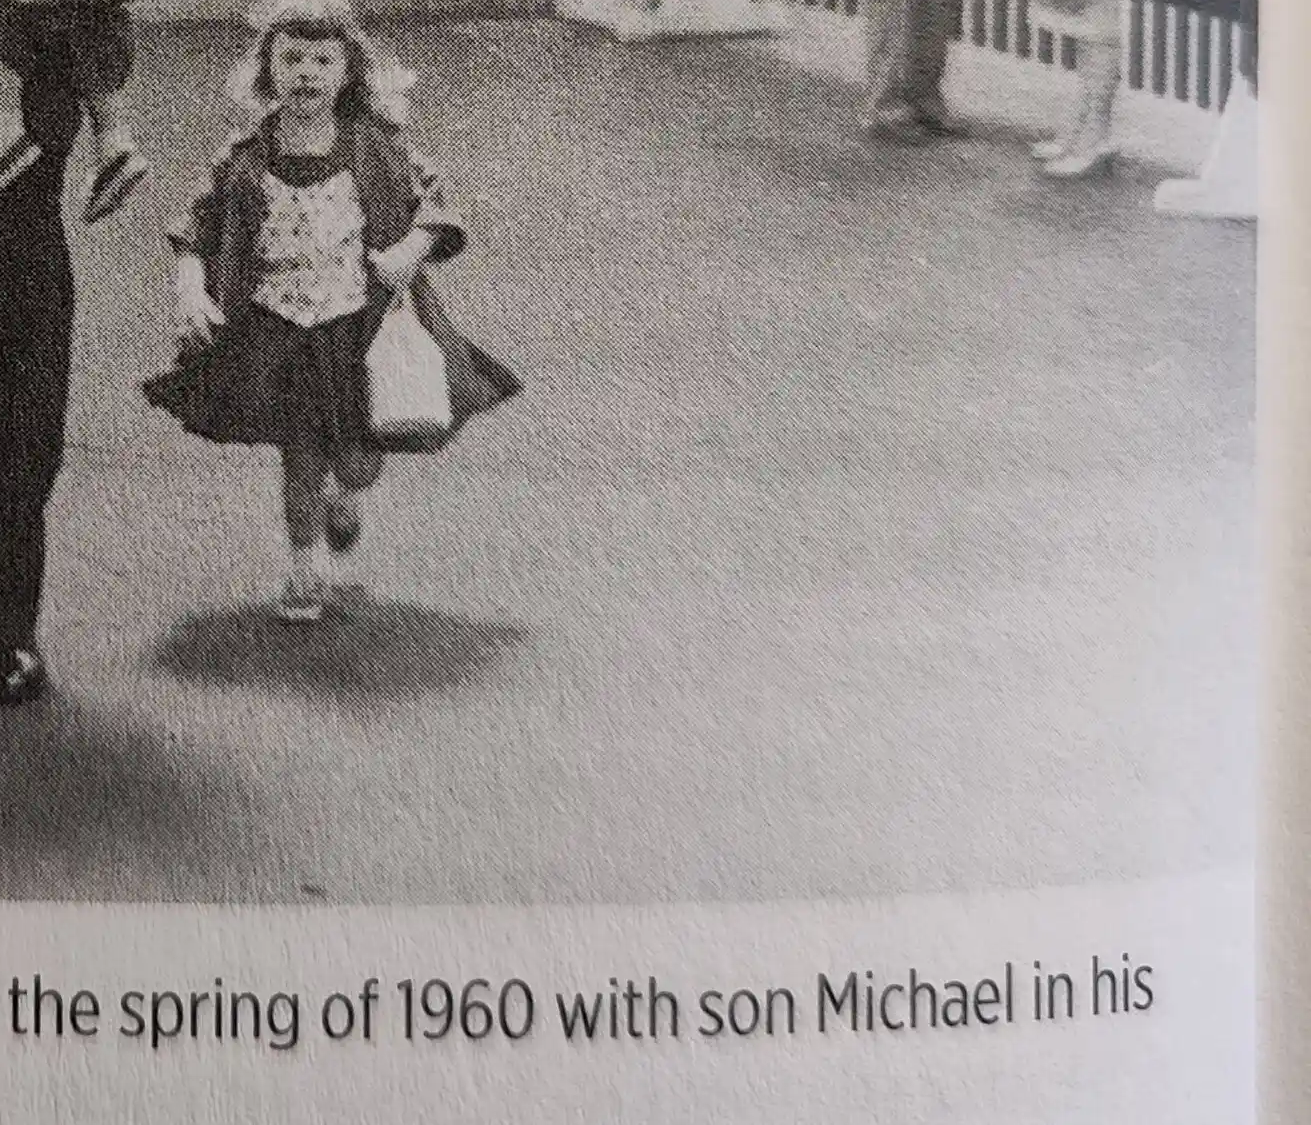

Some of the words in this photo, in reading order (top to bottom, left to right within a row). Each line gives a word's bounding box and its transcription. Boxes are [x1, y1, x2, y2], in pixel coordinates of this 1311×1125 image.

[7, 973, 101, 1039] the
[117, 976, 301, 1053] spring
[320, 976, 381, 1043] of
[395, 977, 536, 1043] 1960
[554, 976, 680, 1042] with
[697, 988, 797, 1038] son
[816, 960, 1015, 1035] Michael
[1032, 959, 1075, 1021] in
[1091, 952, 1155, 1016] his
